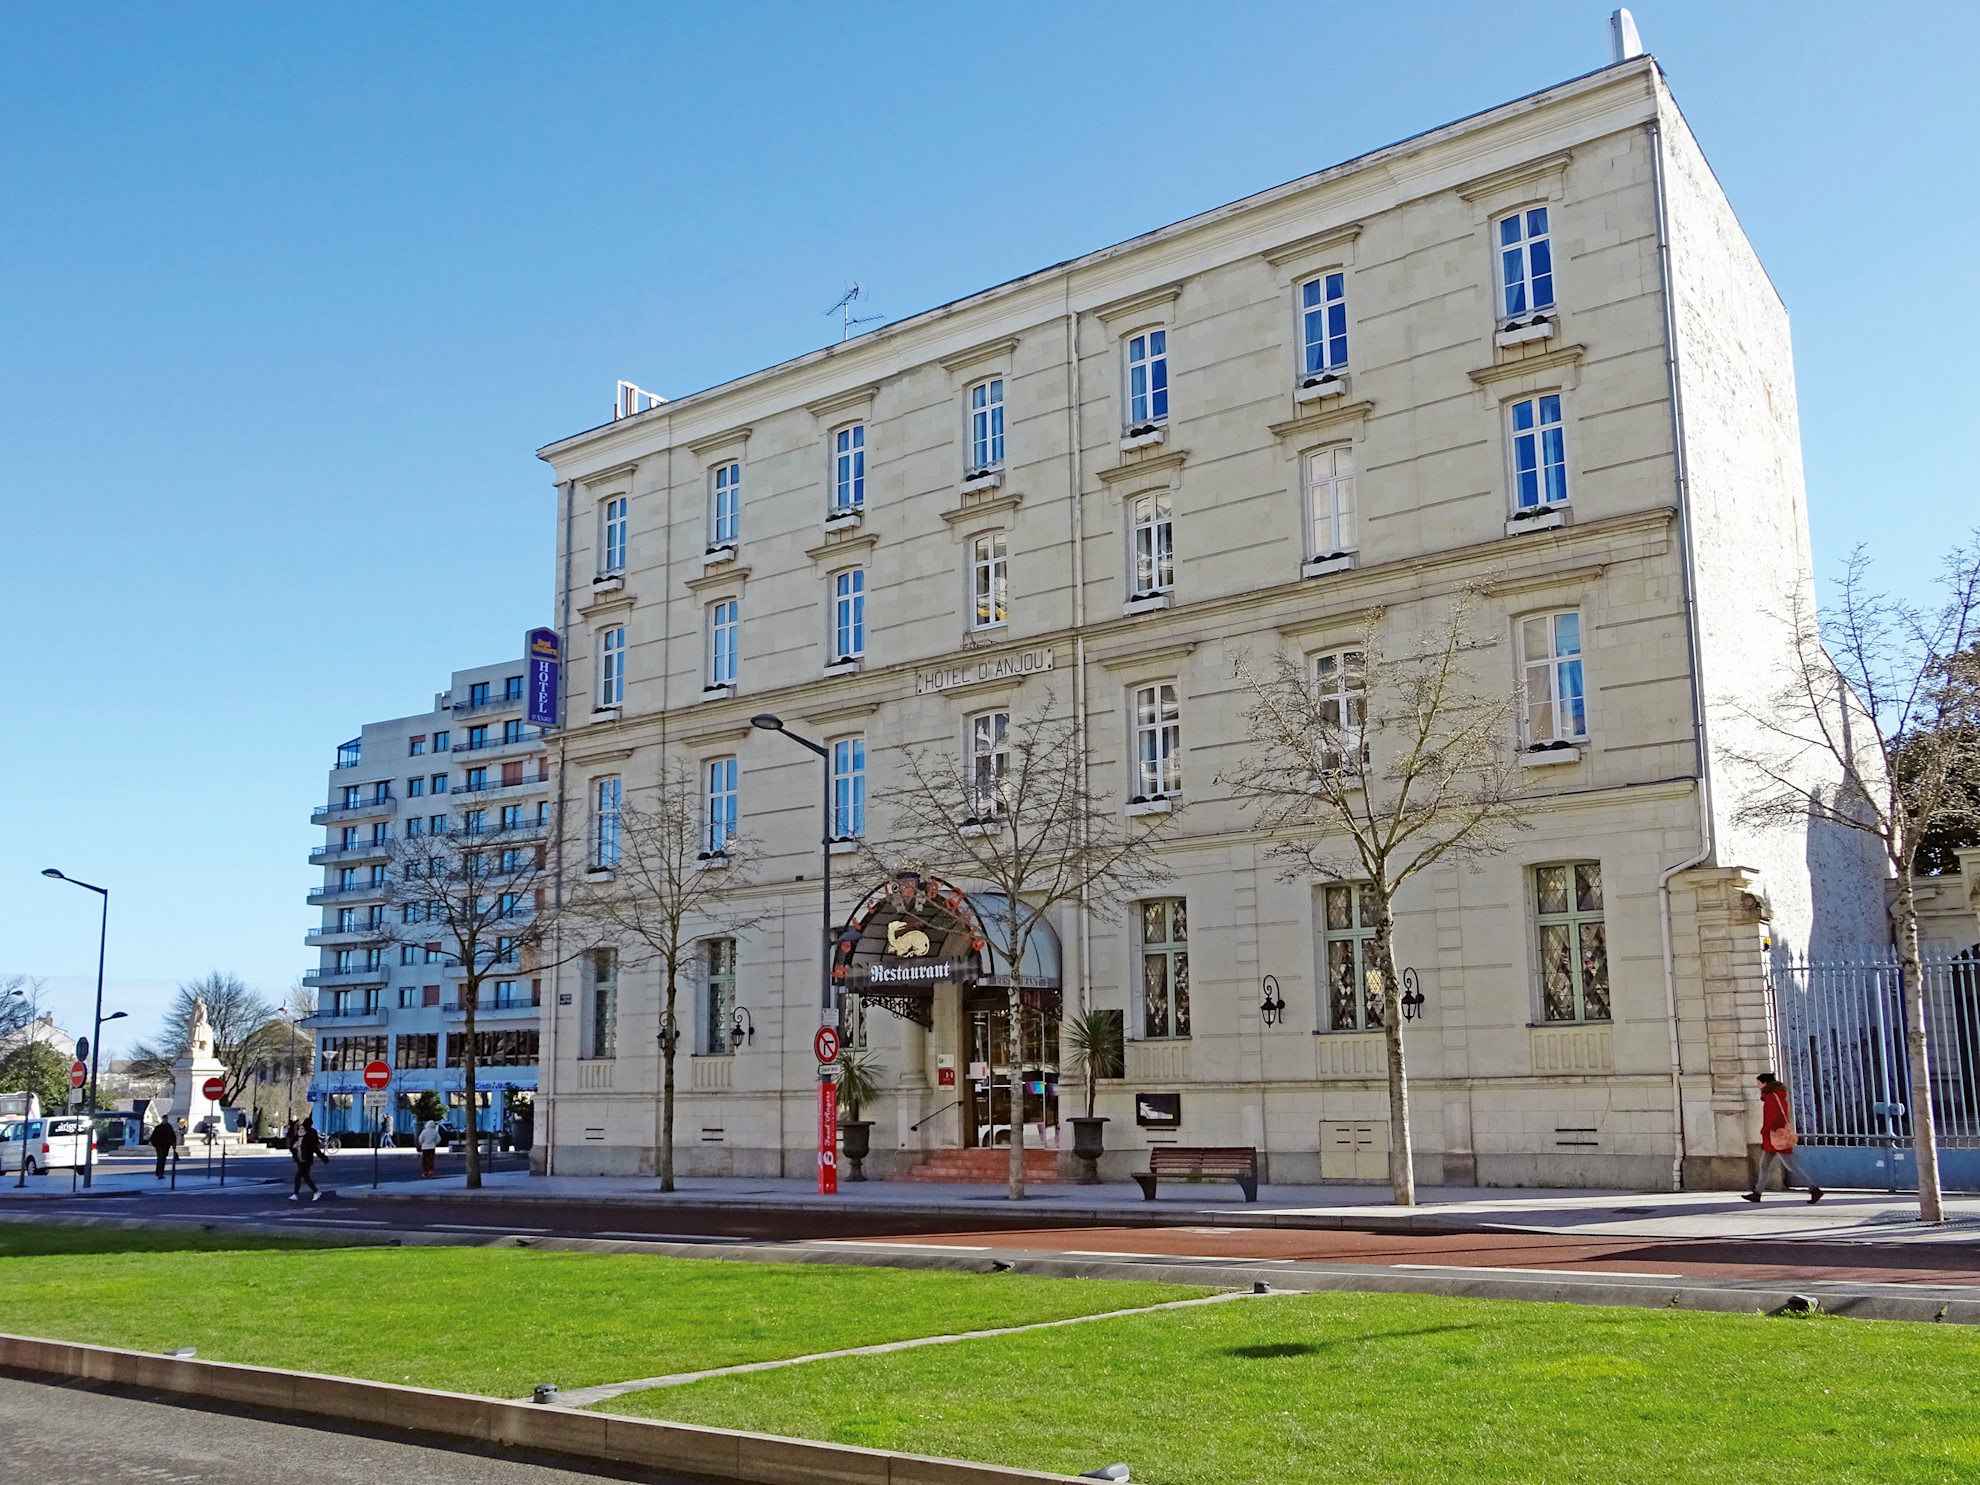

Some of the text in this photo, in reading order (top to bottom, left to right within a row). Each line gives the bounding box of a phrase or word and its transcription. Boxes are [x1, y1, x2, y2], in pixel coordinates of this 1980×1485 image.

[538, 661, 549, 714] HOTEL
[870, 960, 950, 983] Restaurant
[996, 976, 1040, 987] RESRANT
